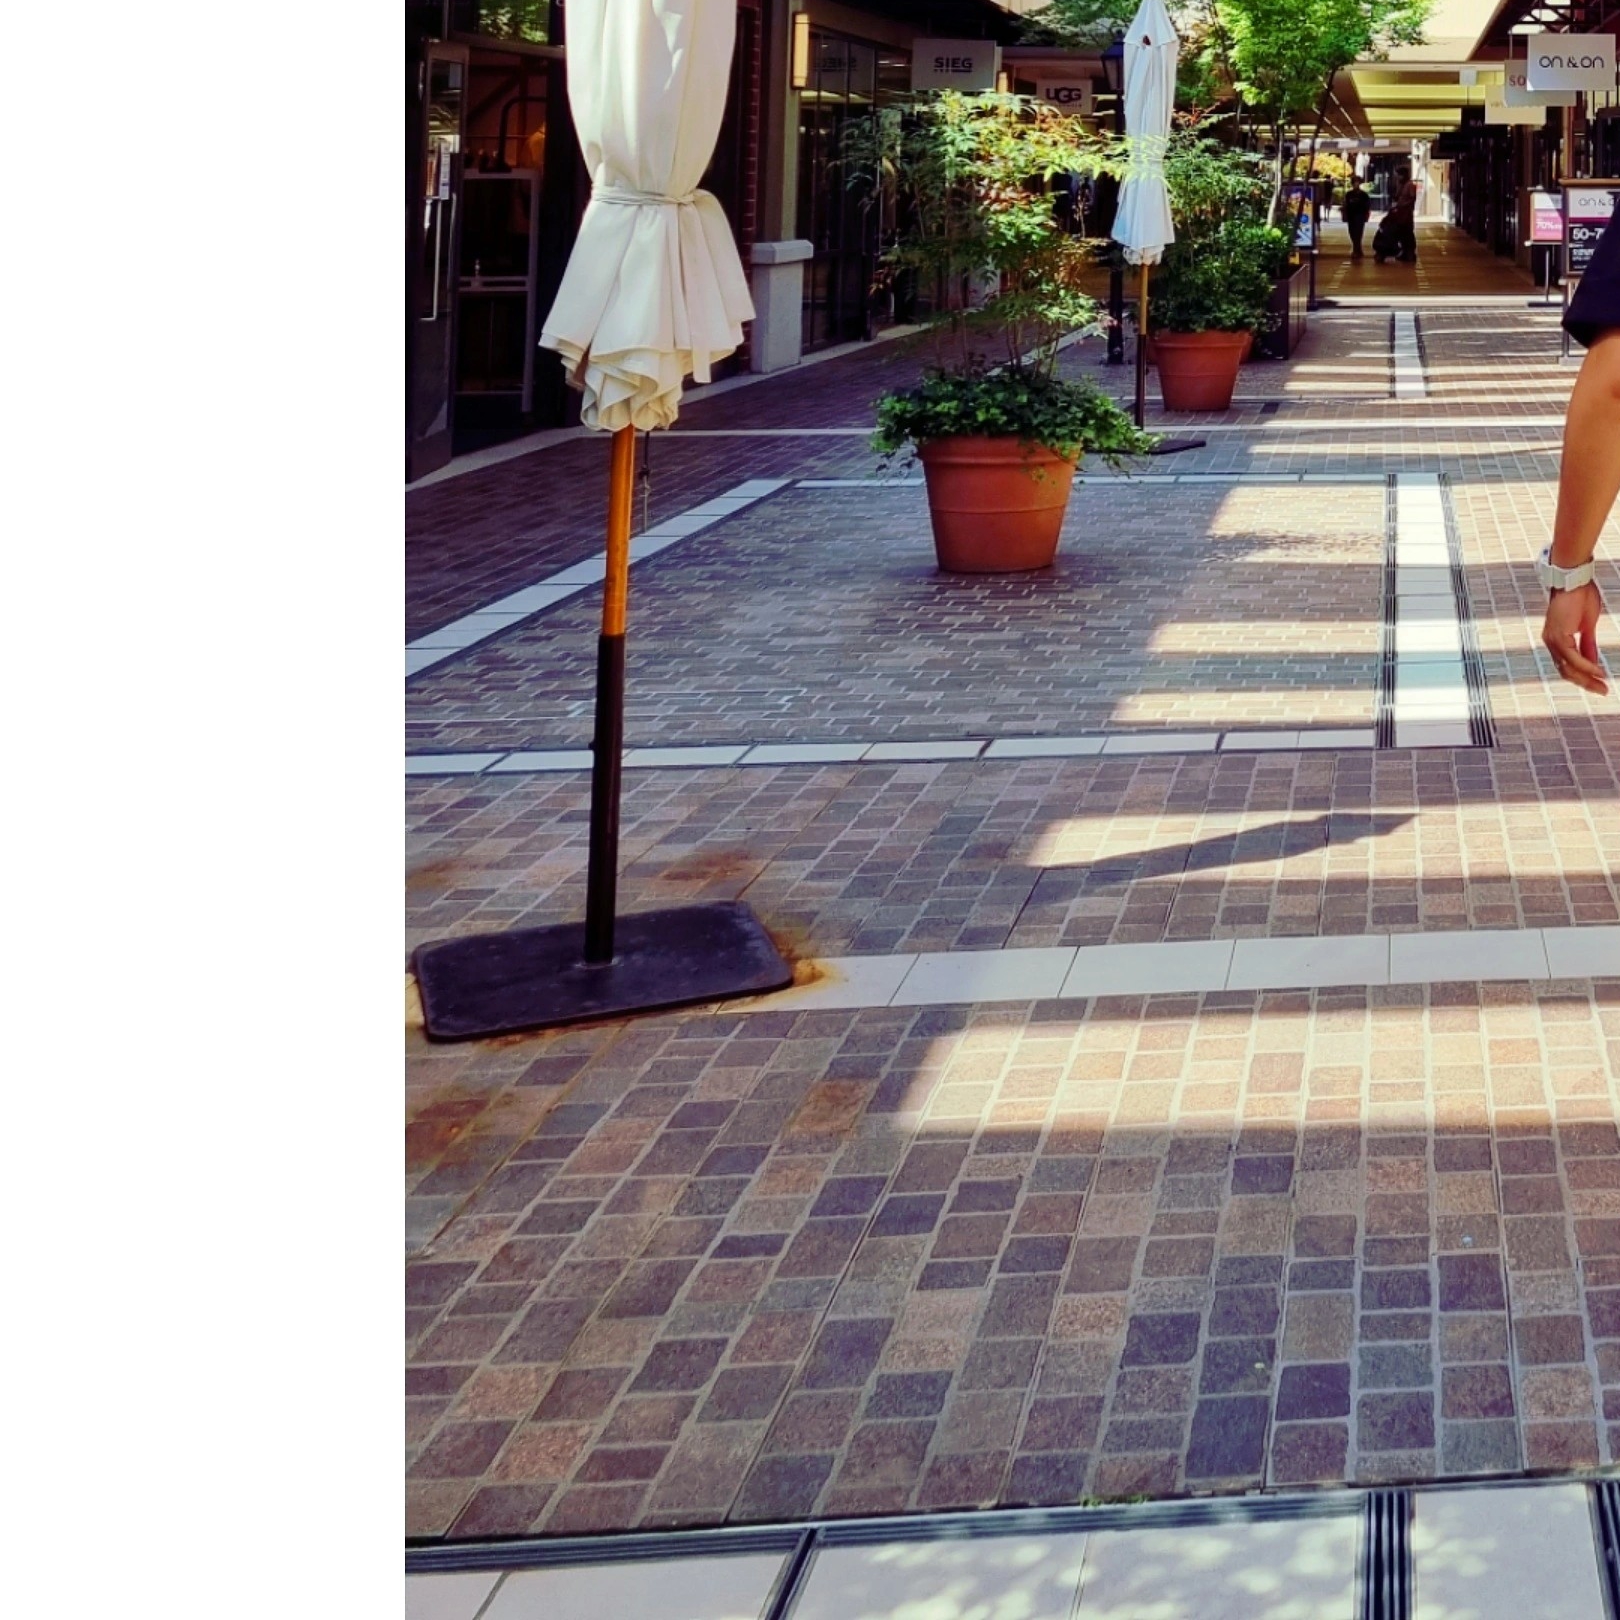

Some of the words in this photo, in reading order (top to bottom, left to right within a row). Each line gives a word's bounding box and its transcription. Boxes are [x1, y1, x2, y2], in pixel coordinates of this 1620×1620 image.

[934, 57, 973, 68] SIEG
[1539, 56, 1563, 68] on
[1567, 56, 1579, 68] &
[1580, 56, 1604, 68] on
[1045, 86, 1083, 104] UGG
